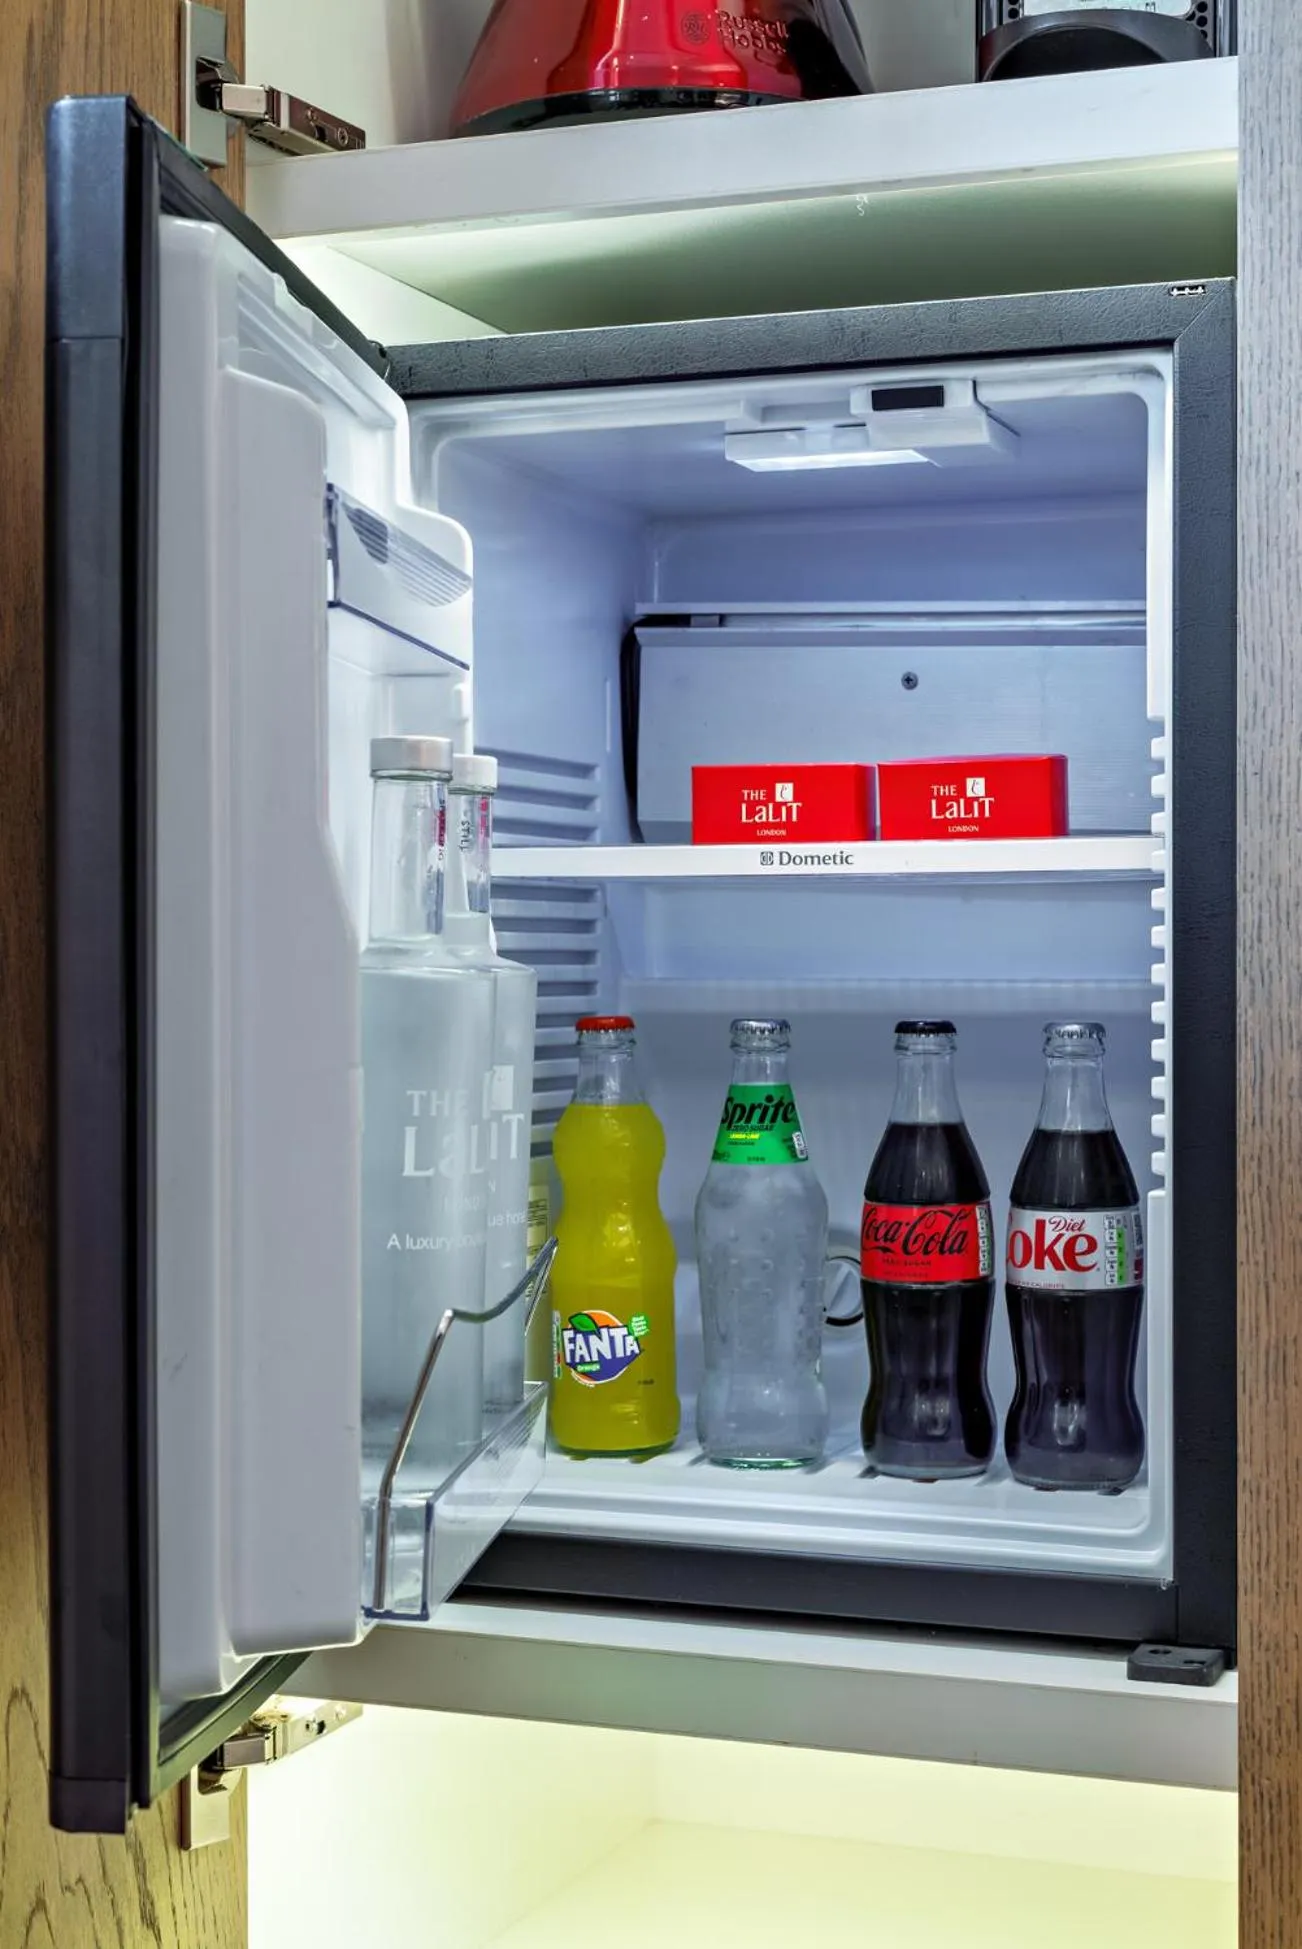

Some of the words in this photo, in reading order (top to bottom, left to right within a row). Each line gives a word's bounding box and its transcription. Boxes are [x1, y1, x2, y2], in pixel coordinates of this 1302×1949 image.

[715, 9, 789, 39] Russell
[717, 28, 787, 55] Hobbs
[741, 789, 767, 801] THE
[931, 784, 958, 796] THE
[756, 829, 787, 837] LONDON
[947, 825, 979, 833] LONDON
[779, 850, 854, 866] Dometic
[721, 1093, 796, 1131] Sprite
[863, 1206, 972, 1256] Coca-Cola
[1048, 1215, 1085, 1233] Diet
[387, 1233, 402, 1250] A
[406, 1233, 451, 1252] luxury
[1007, 1217, 1099, 1273] oke
[562, 1327, 640, 1363] FANTA
